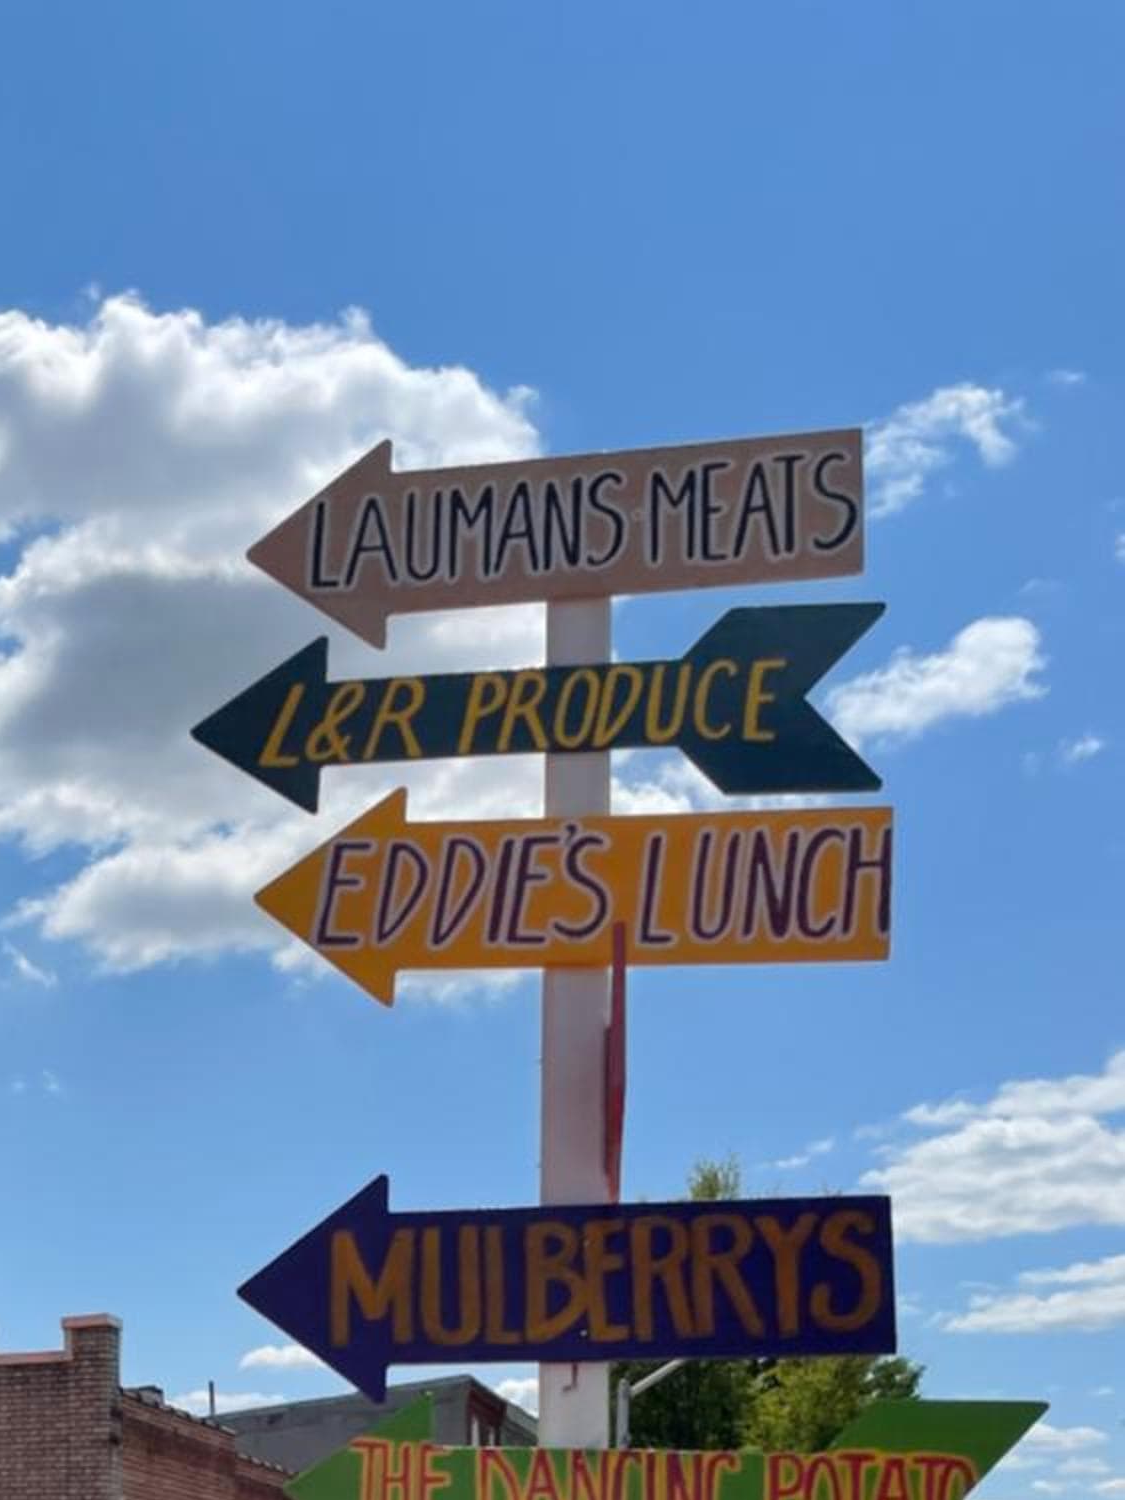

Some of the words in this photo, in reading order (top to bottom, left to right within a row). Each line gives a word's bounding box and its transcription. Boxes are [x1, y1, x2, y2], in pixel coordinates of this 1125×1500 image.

[309, 470, 625, 588] LAUMANS
[651, 452, 858, 564] MEATS
[258, 677, 425, 768] L&R
[457, 659, 787, 755] PRODUCE
[316, 824, 609, 945] EDDIE'S
[639, 827, 892, 943] LUNCH
[329, 1211, 878, 1347] MULBERRYS
